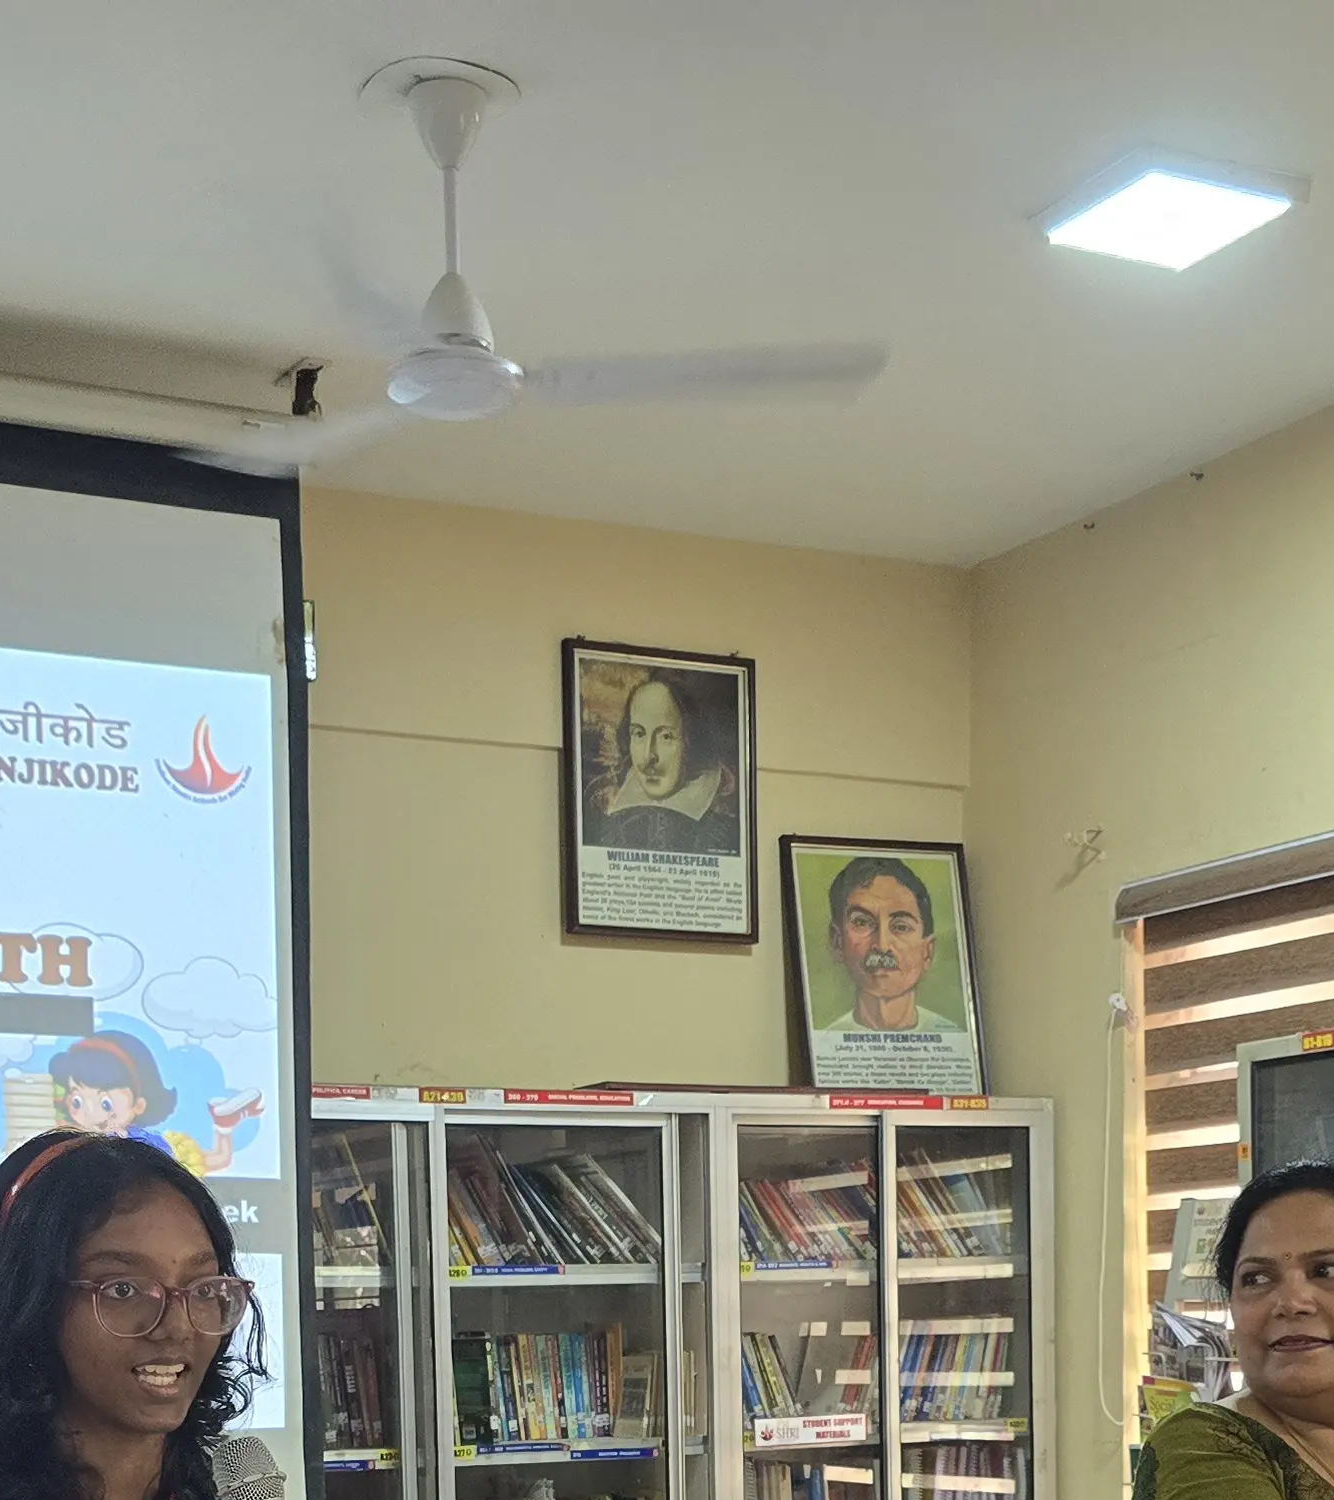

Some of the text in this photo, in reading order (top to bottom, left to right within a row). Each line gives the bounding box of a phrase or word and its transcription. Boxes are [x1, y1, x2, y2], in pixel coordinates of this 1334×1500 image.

[607, 851, 719, 868] WILLIAM SHAKESPEARE
[884, 1033, 942, 1043] PREMCHAND
